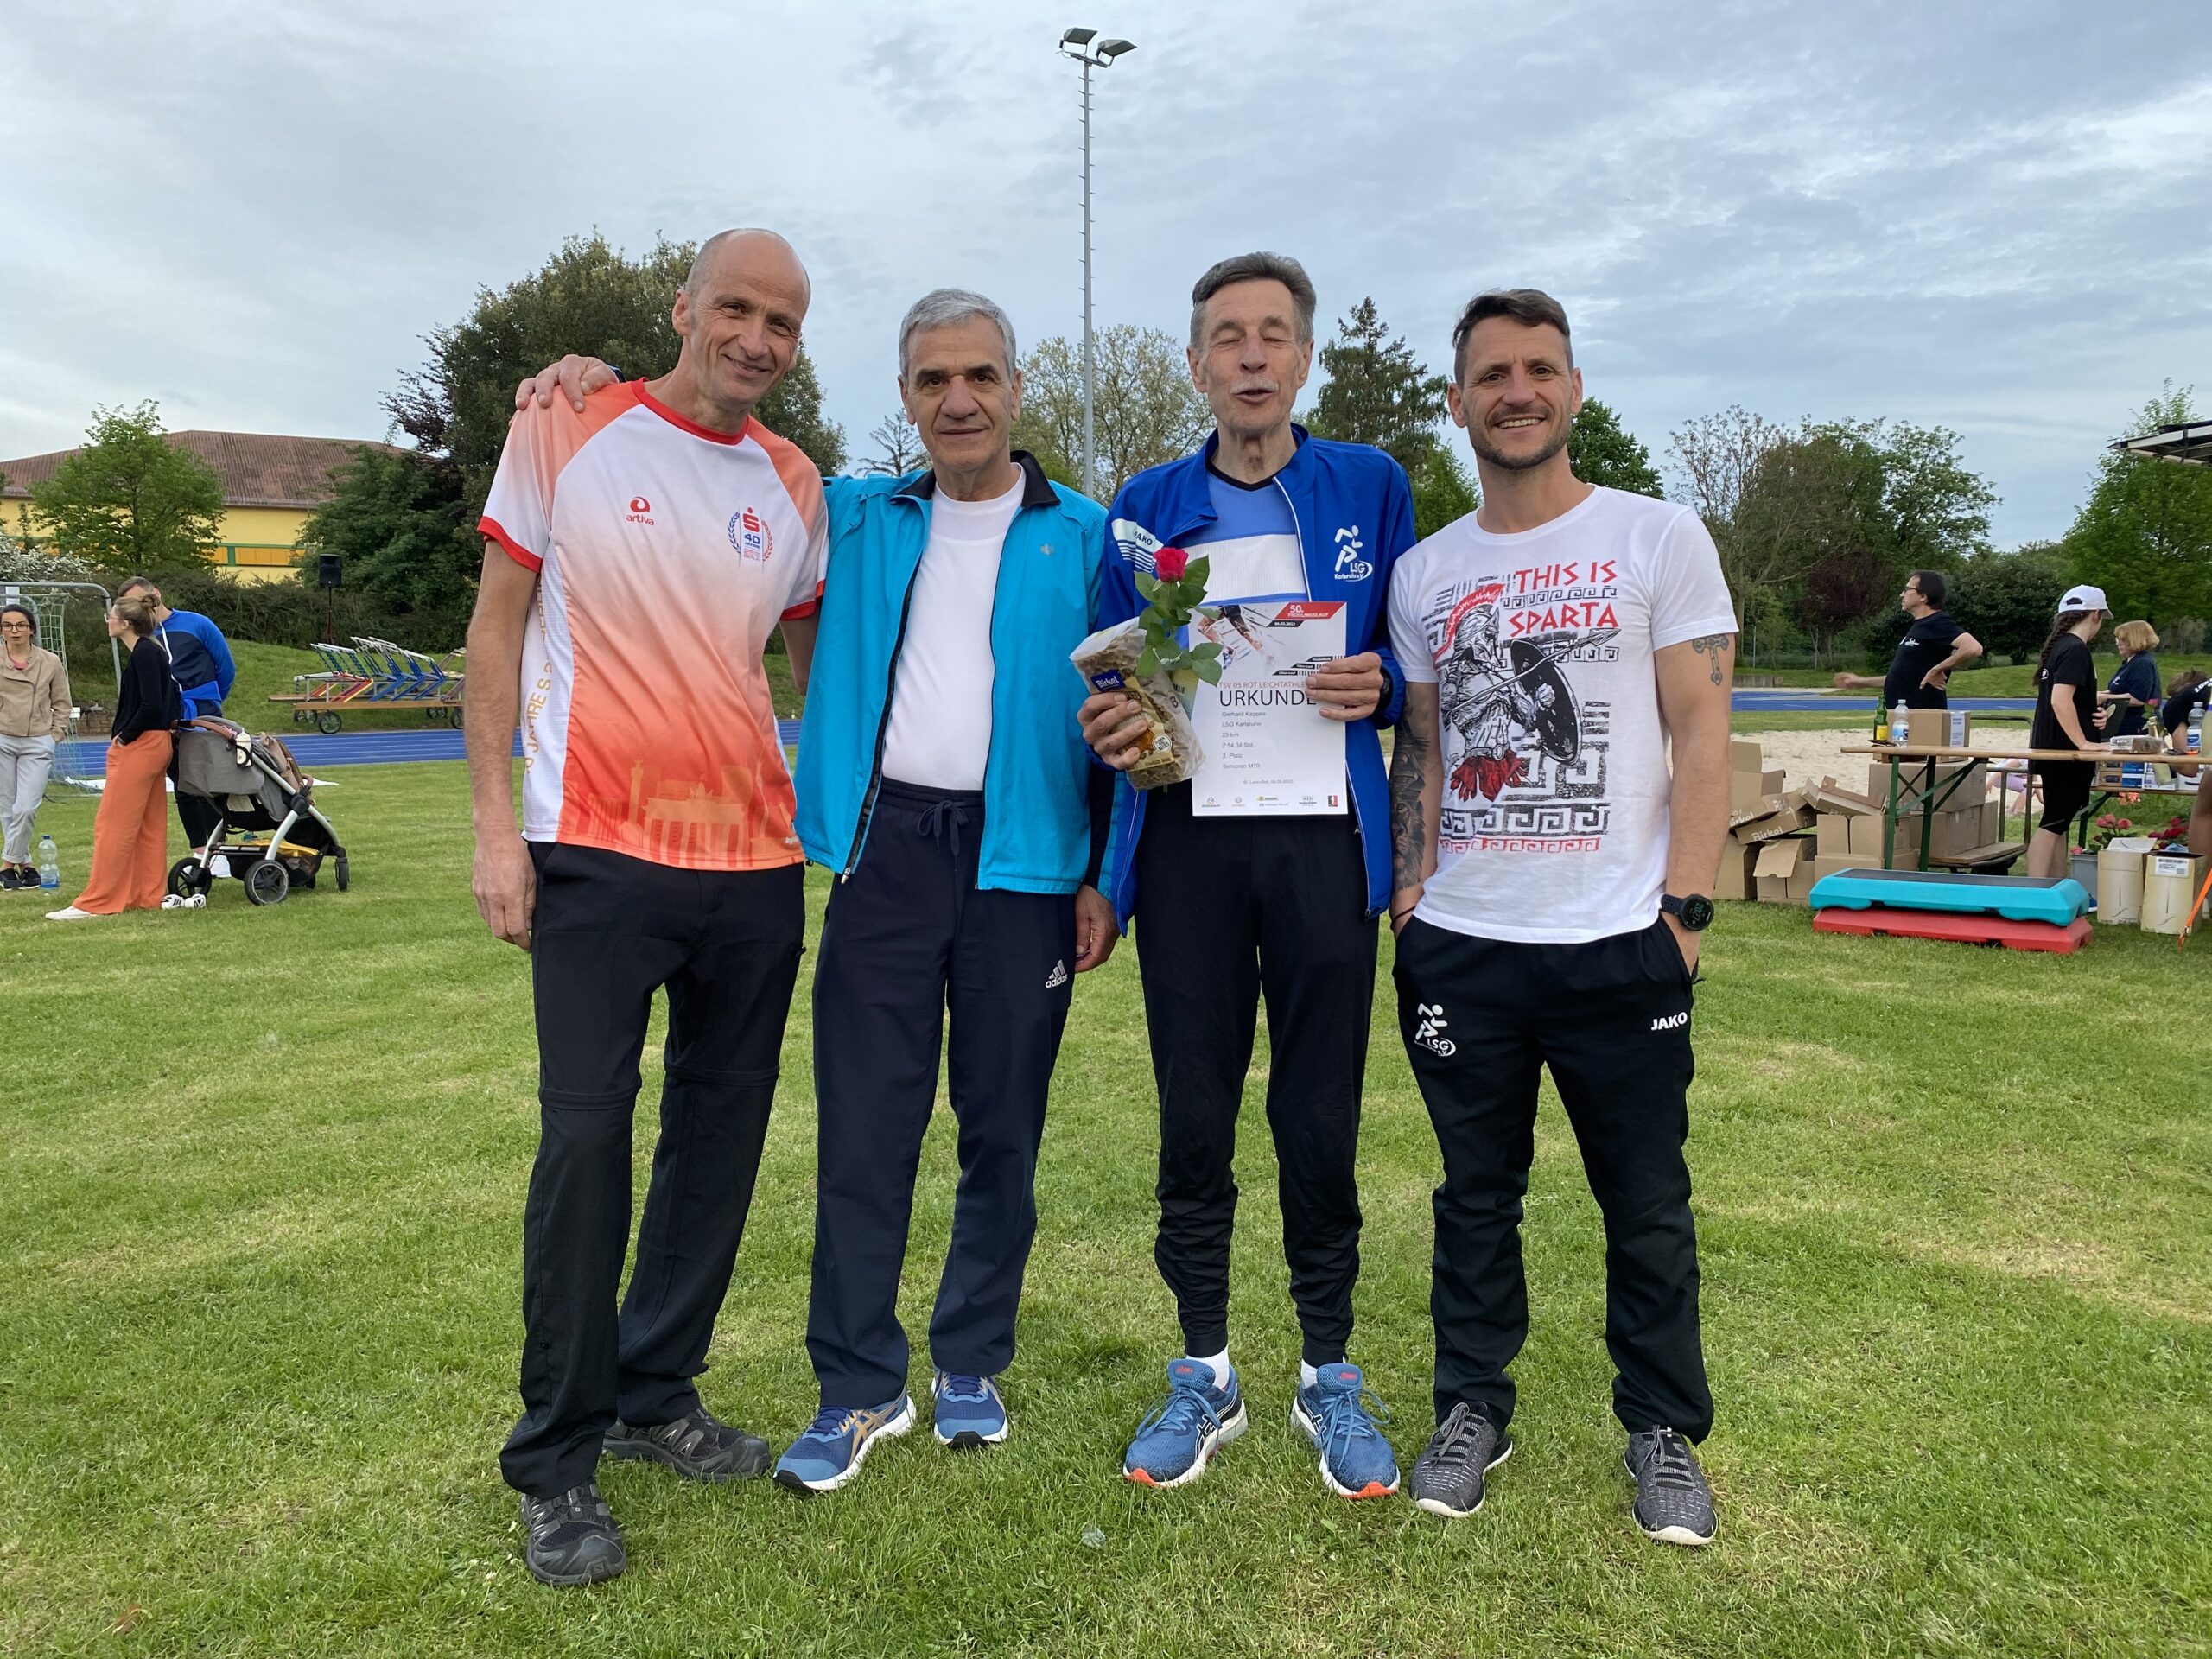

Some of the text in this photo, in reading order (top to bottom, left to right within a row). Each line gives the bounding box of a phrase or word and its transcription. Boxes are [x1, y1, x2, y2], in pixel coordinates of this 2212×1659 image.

[626, 514, 655, 526] artiva
[744, 533, 760, 544] 40
[1350, 563, 1366, 573] LSG
[1516, 559, 1618, 594] THIS IS
[1289, 604, 1305, 613] 50.
[1508, 602, 1619, 638] SPARTA
[1096, 676, 1121, 689] Birkel
[1751, 826, 1783, 842] Birkel
[1045, 974, 1068, 988] adidas
[1650, 1011, 1688, 1031] JAKO
[1427, 1038, 1449, 1051] LSG
